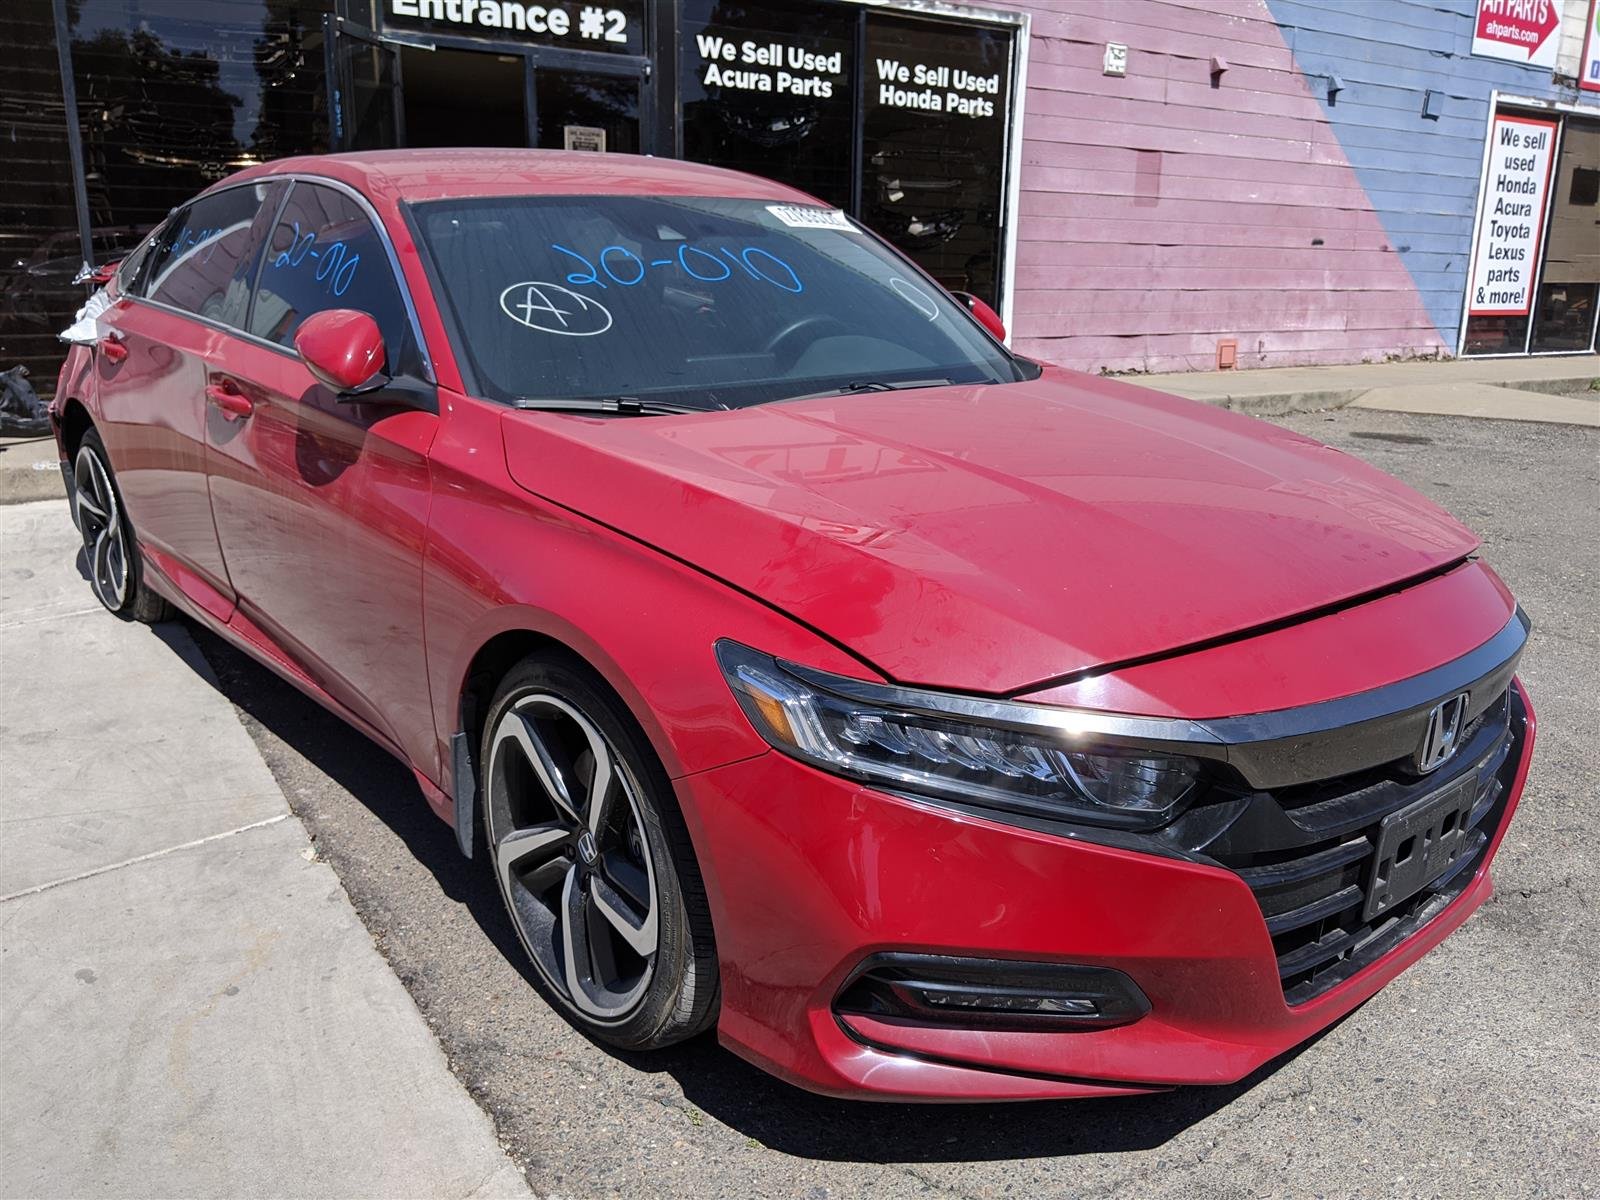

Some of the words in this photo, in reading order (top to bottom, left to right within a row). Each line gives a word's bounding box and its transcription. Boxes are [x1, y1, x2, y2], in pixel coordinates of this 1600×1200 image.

[392, 0, 571, 36] Entrance
[579, 6, 628, 43] #2
[1506, 0, 1549, 25] PARTS
[1486, 20, 1539, 44] ahparts.com
[696, 34, 737, 61] We
[741, 41, 783, 67] Sell
[788, 47, 842, 74] Used
[704, 63, 772, 92] Acura
[776, 71, 833, 98] Parts
[876, 58, 910, 83] We
[914, 64, 949, 88] Sell
[953, 69, 999, 94] Used
[879, 84, 942, 111] Honda
[946, 92, 994, 117] Parts
[1500, 127, 1520, 149] We
[1523, 132, 1547, 150] sell
[1504, 155, 1535, 172] used
[1496, 174, 1537, 195] Honda
[1494, 197, 1532, 217] Acura
[1490, 220, 1531, 242] Toyota
[1488, 242, 1526, 261] Lexus
[552, 244, 803, 293] 20-010
[1487, 266, 1520, 286] parts
[1476, 286, 1486, 304] &
[1489, 287, 1525, 304] more!
